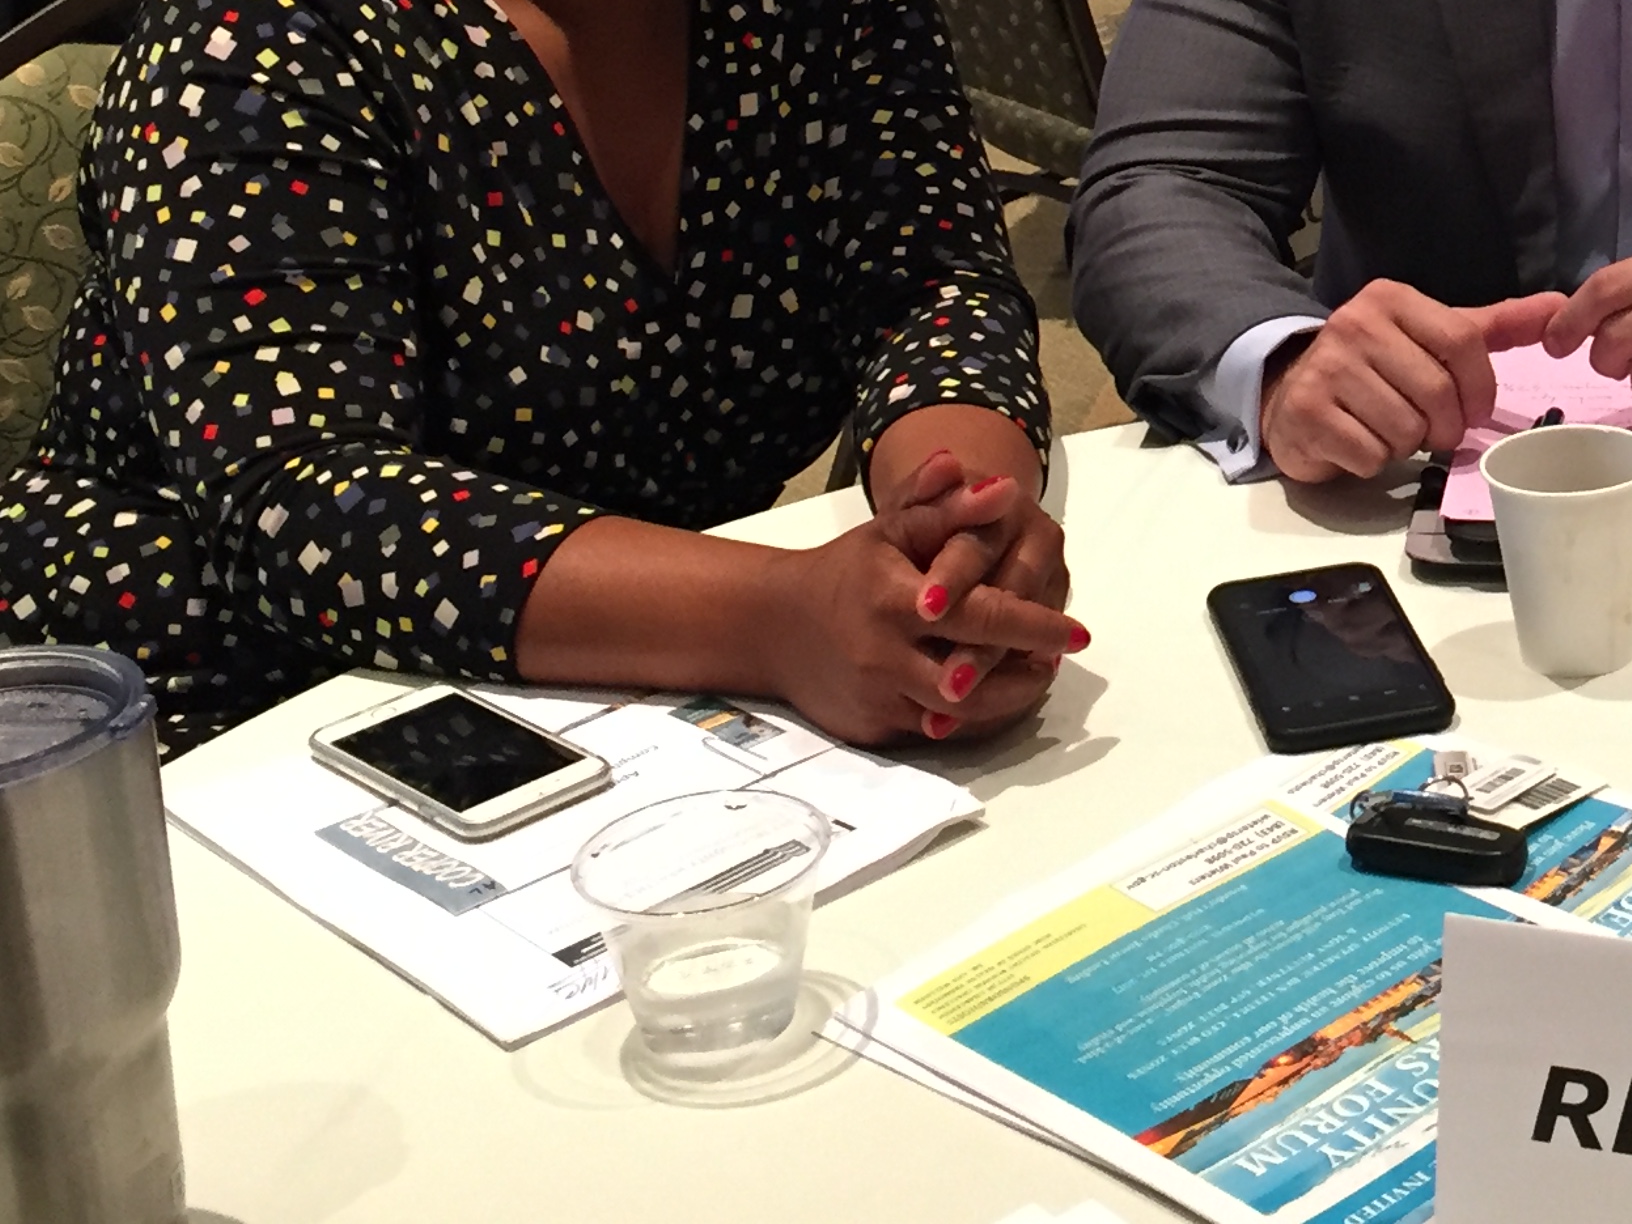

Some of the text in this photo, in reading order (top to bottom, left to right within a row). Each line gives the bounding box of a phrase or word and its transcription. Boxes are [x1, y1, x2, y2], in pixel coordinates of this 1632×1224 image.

[391, 842, 486, 889] COOPER
[1233, 1077, 1396, 1177] FORUM
[1315, 1078, 1441, 1169] UNITY
